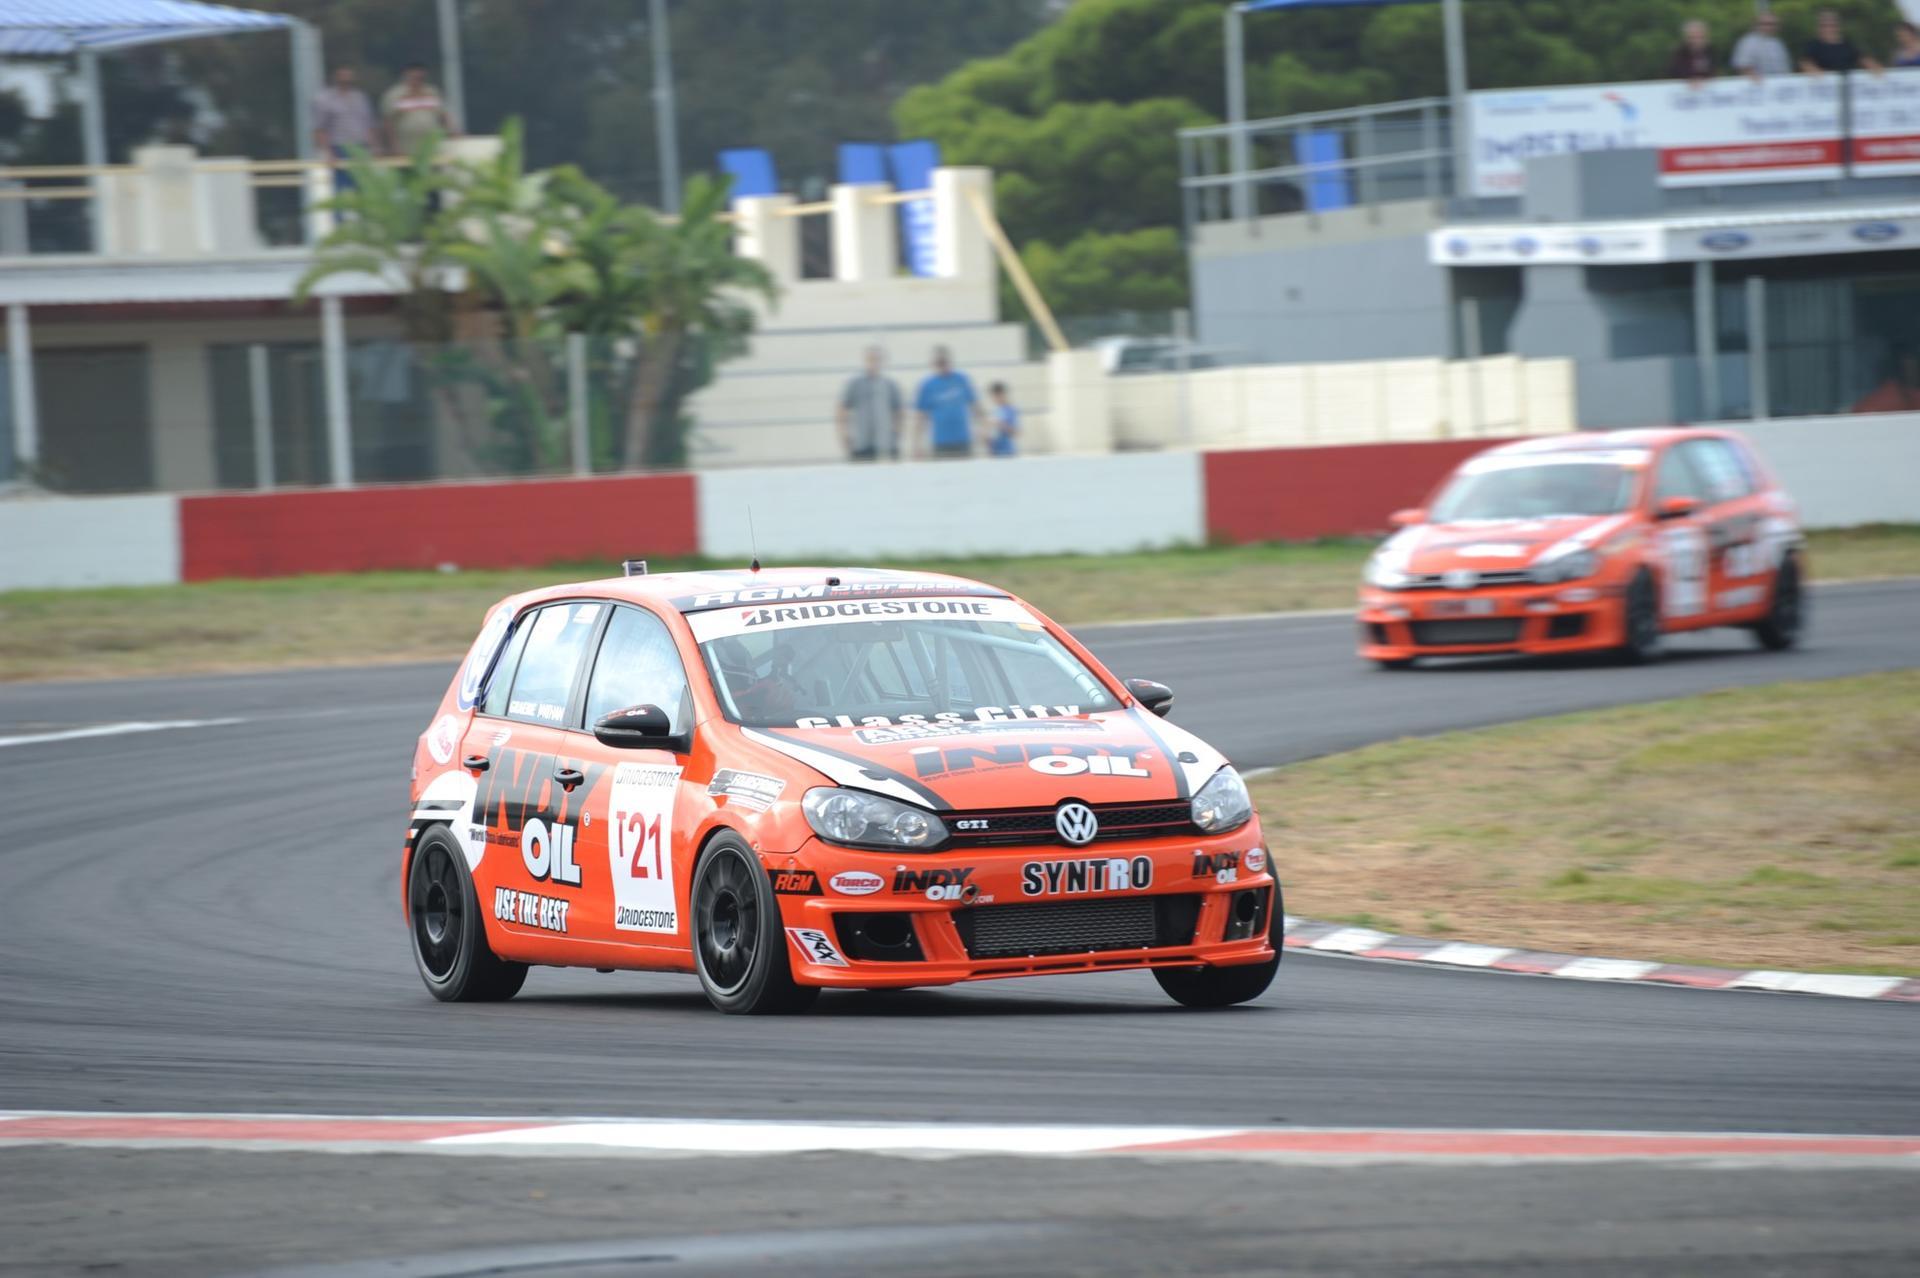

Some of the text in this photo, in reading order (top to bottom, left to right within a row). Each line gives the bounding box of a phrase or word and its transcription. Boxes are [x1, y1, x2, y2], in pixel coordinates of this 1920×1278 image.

[741, 601, 992, 627] BRIDGESTONE
[1028, 755, 1152, 778] OIL
[956, 819, 990, 830] GTI
[521, 816, 582, 888] OIL
[775, 873, 814, 892] RGM
[892, 864, 975, 893] INDY
[1022, 855, 1153, 896] SYNTRO
[1216, 867, 1237, 884] OIL
[925, 884, 962, 900] OIL
[494, 886, 570, 933] USE THE BEST
[617, 905, 675, 929] BRIDGESTONE
